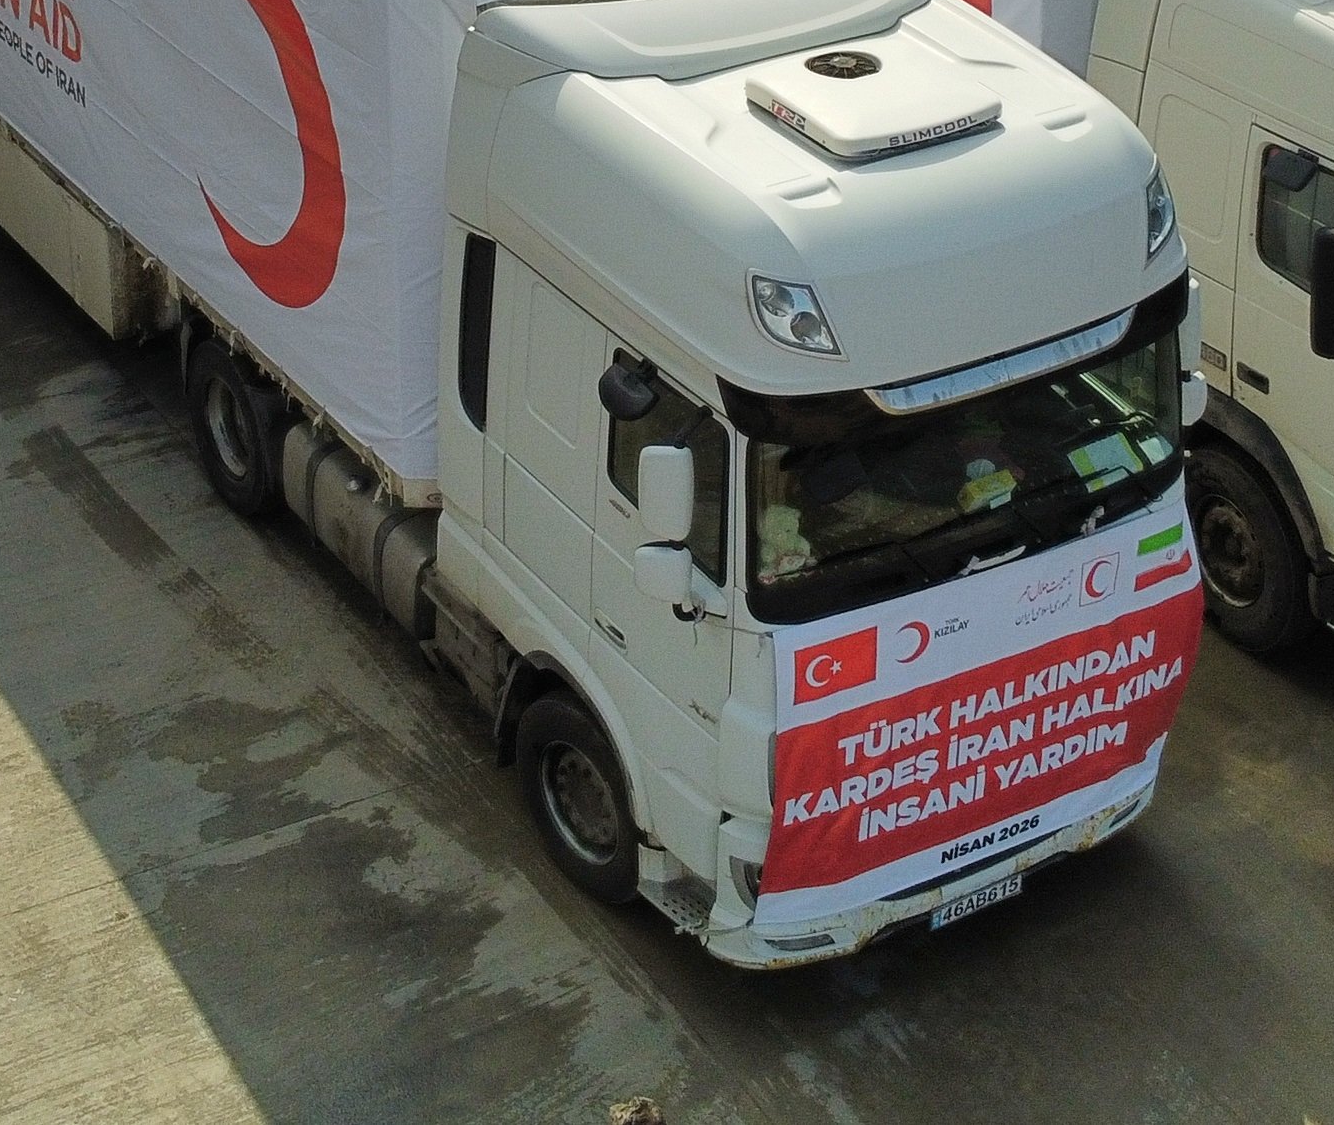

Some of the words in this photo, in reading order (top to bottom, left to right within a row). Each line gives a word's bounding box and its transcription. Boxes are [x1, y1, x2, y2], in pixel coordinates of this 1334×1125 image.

[35, 51, 53, 83] OF
[56, 66, 86, 108] IRAN
[889, 115, 977, 147] SLIMCOOL
[934, 619, 970, 639] KIZILAY
[838, 706, 943, 766] TÜRK
[949, 630, 1156, 729] HALKINDAN
[783, 749, 940, 827] KARDEŞ
[946, 713, 1035, 770] İRAN
[1042, 656, 1183, 735] HALKINA
[858, 764, 986, 843] İNSANİ
[994, 721, 1128, 790] YARDIM
[940, 832, 995, 864] NİSAN
[998, 814, 1040, 842] 2026
